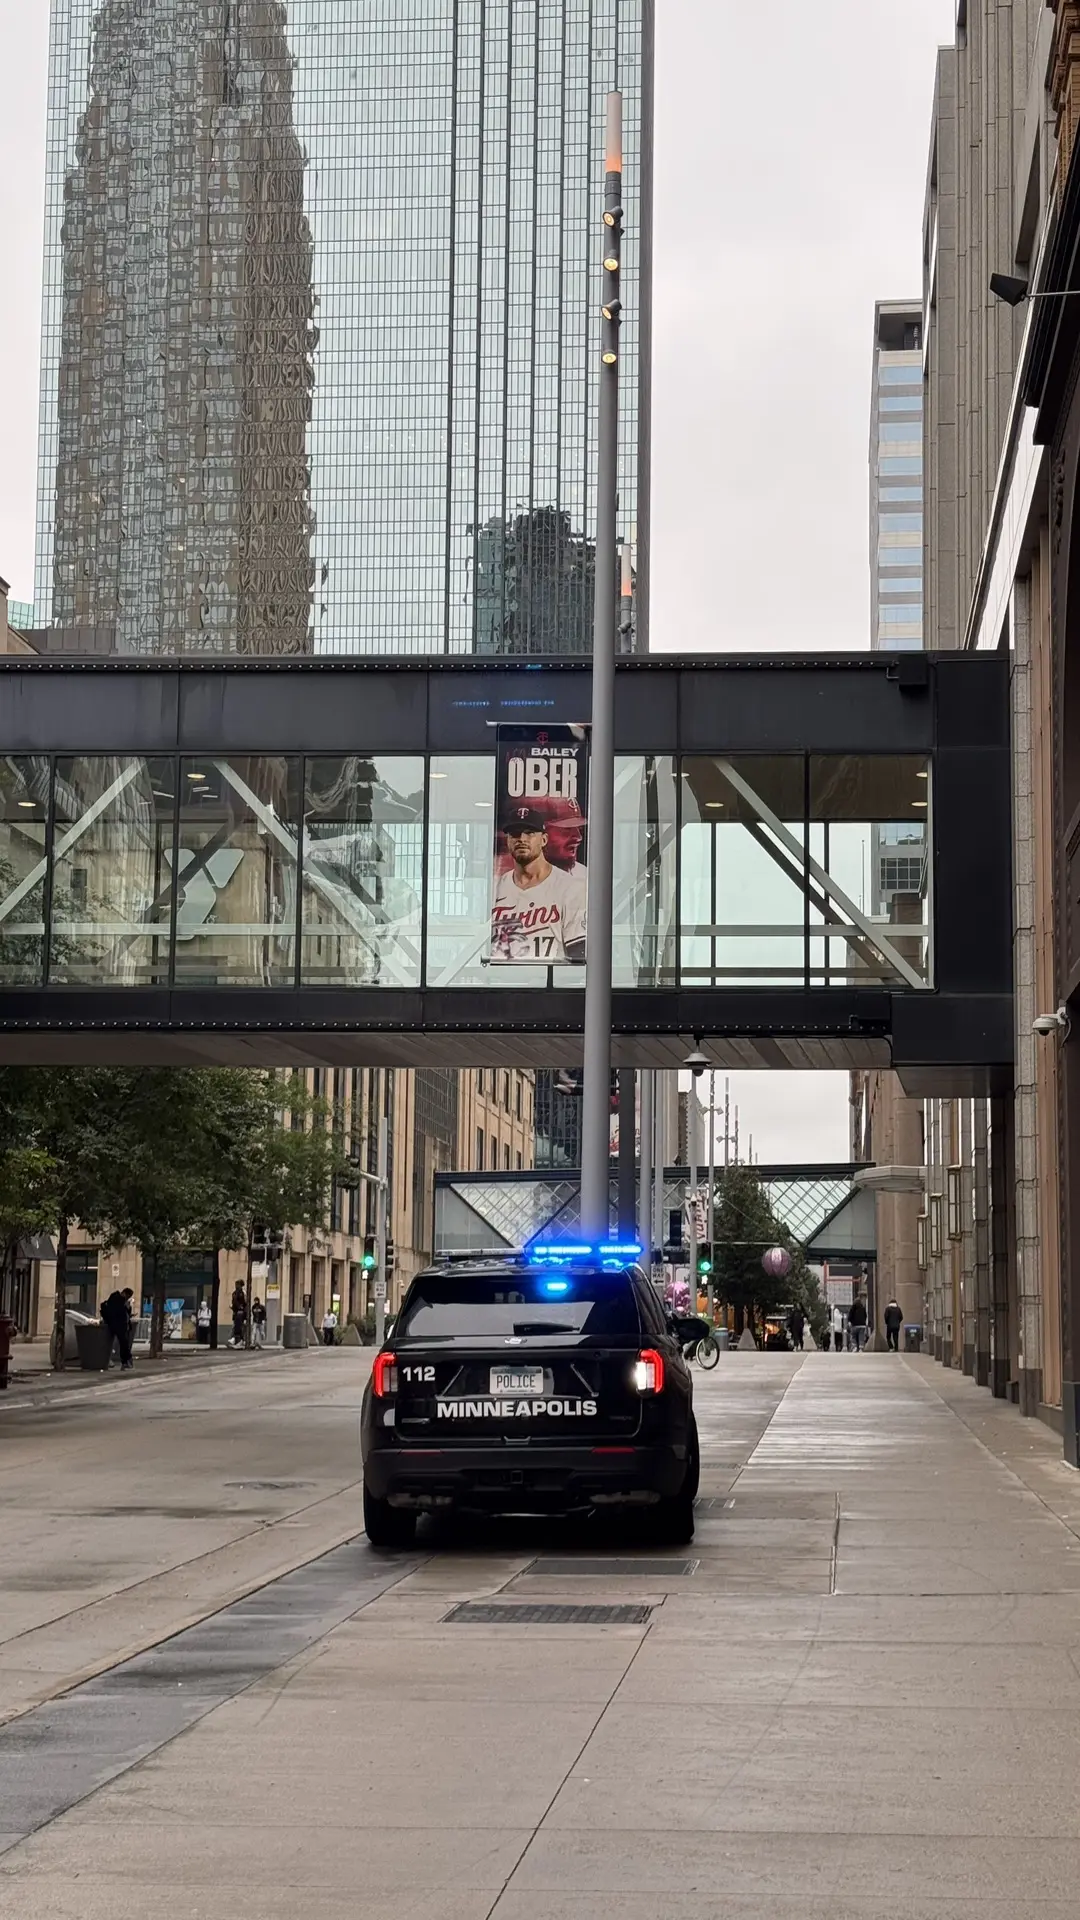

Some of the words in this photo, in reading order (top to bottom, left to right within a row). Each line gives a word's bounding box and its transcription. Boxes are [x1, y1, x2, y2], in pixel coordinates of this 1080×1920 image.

[531, 748, 579, 757] BAILEY
[508, 757, 578, 798] OBER
[492, 902, 560, 928] Twins
[533, 936, 555, 957] 17
[402, 1366, 436, 1381] 112
[496, 1374, 536, 1388] POLICE
[437, 1400, 598, 1418] MINNEAPOLIS
